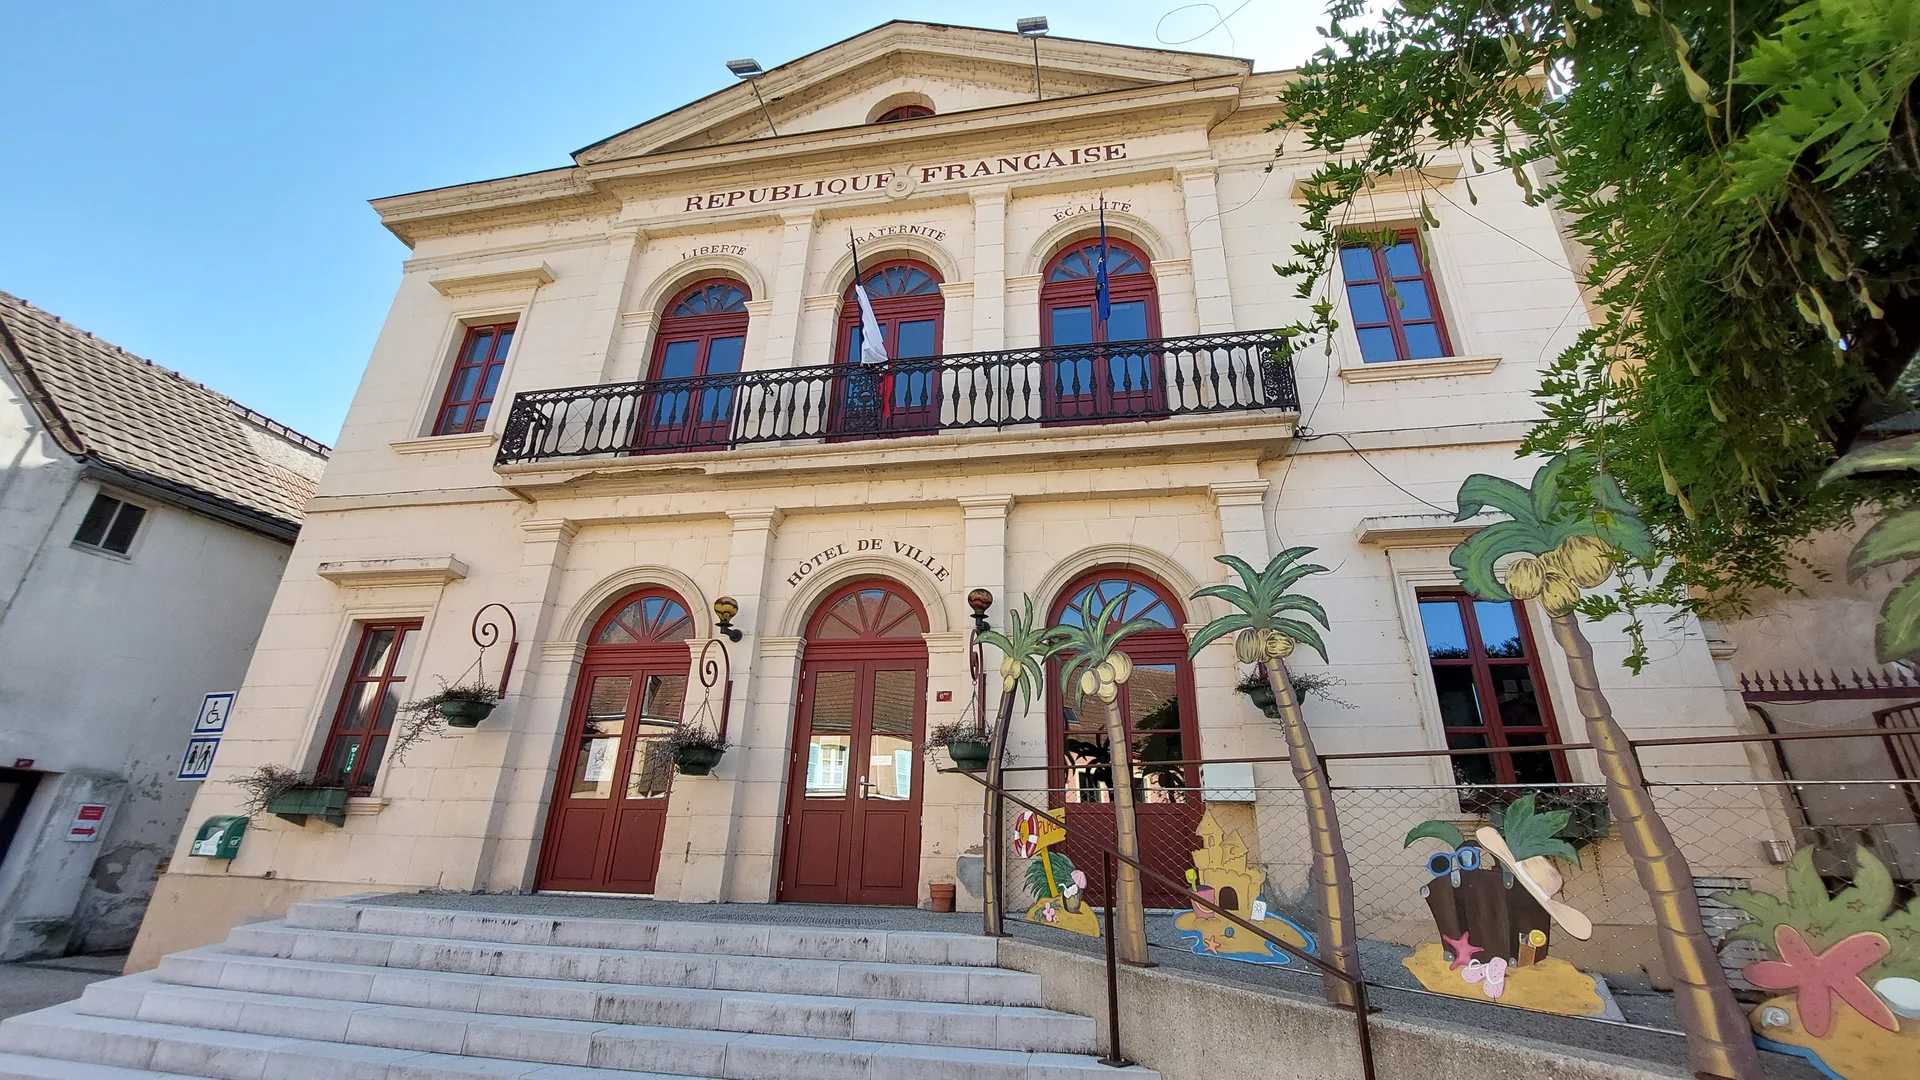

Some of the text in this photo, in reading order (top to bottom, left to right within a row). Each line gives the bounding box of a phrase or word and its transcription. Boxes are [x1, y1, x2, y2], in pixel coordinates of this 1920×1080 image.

[1053, 199, 1132, 222] ÉGALITÉ
[845, 225, 946, 250] FRATERNITÉ
[682, 244, 750, 260] LIBERTÉ
[786, 538, 950, 588] HÔTEL DE VILLE
